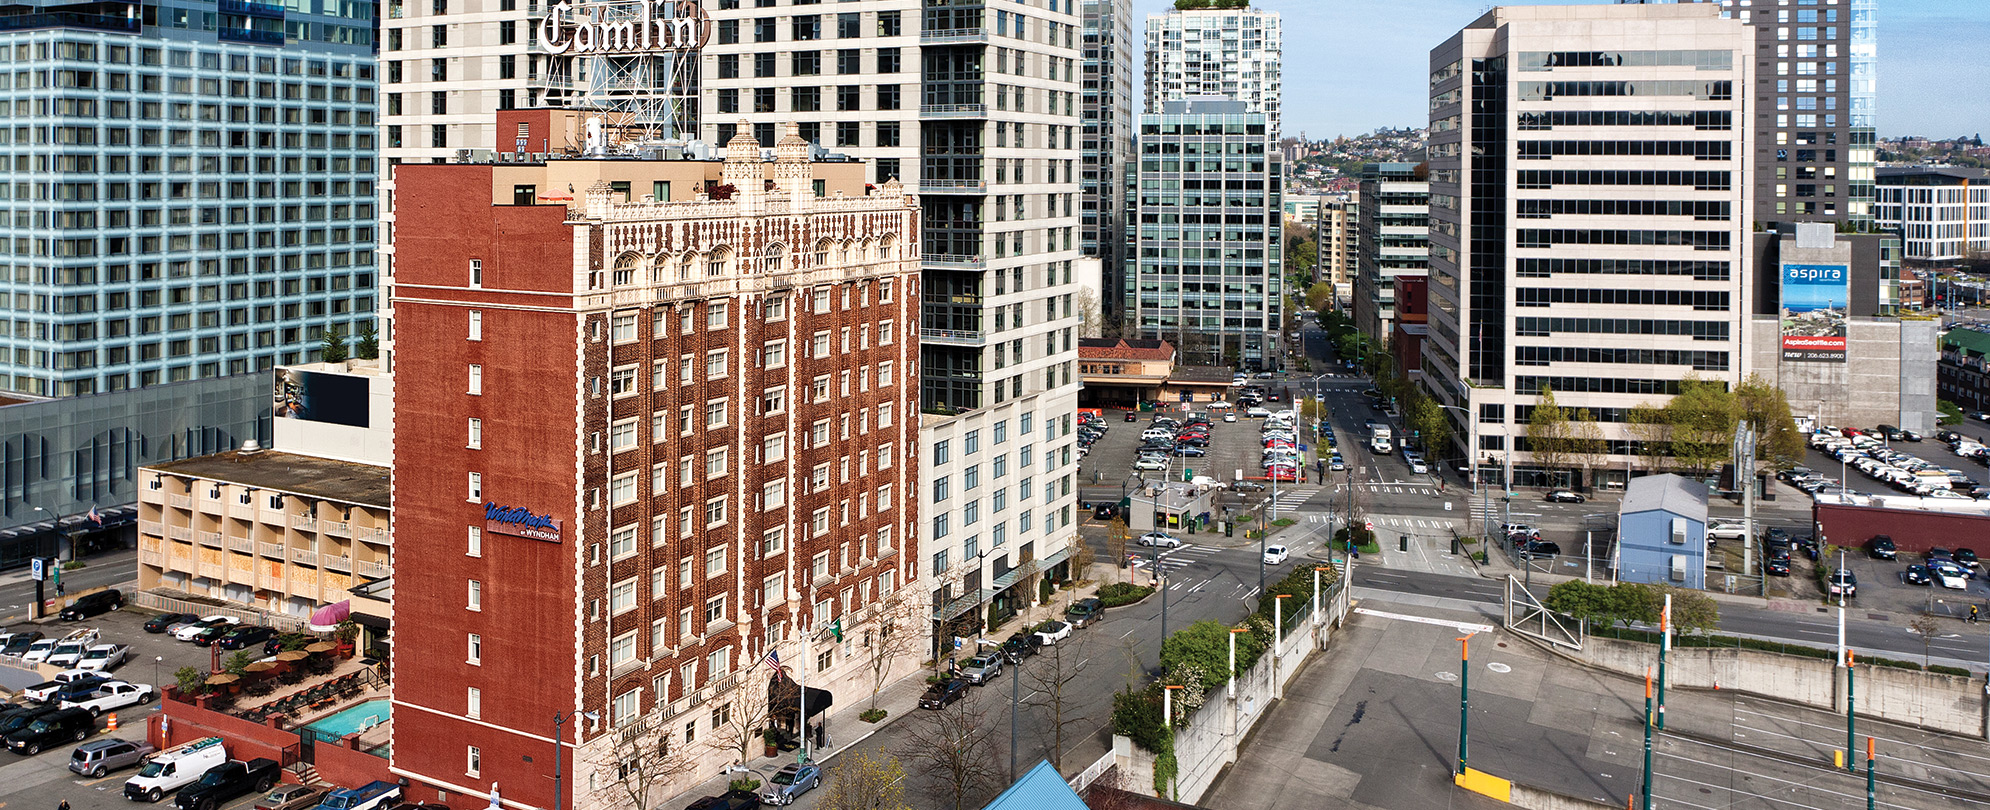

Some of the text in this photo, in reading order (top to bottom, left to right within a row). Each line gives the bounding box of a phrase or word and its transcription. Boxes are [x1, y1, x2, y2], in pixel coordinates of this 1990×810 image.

[540, 0, 700, 54] Camlin
[1790, 269, 1841, 281] aspira
[484, 501, 559, 532] WorldMark
[526, 530, 560, 541] WYNDHAM
